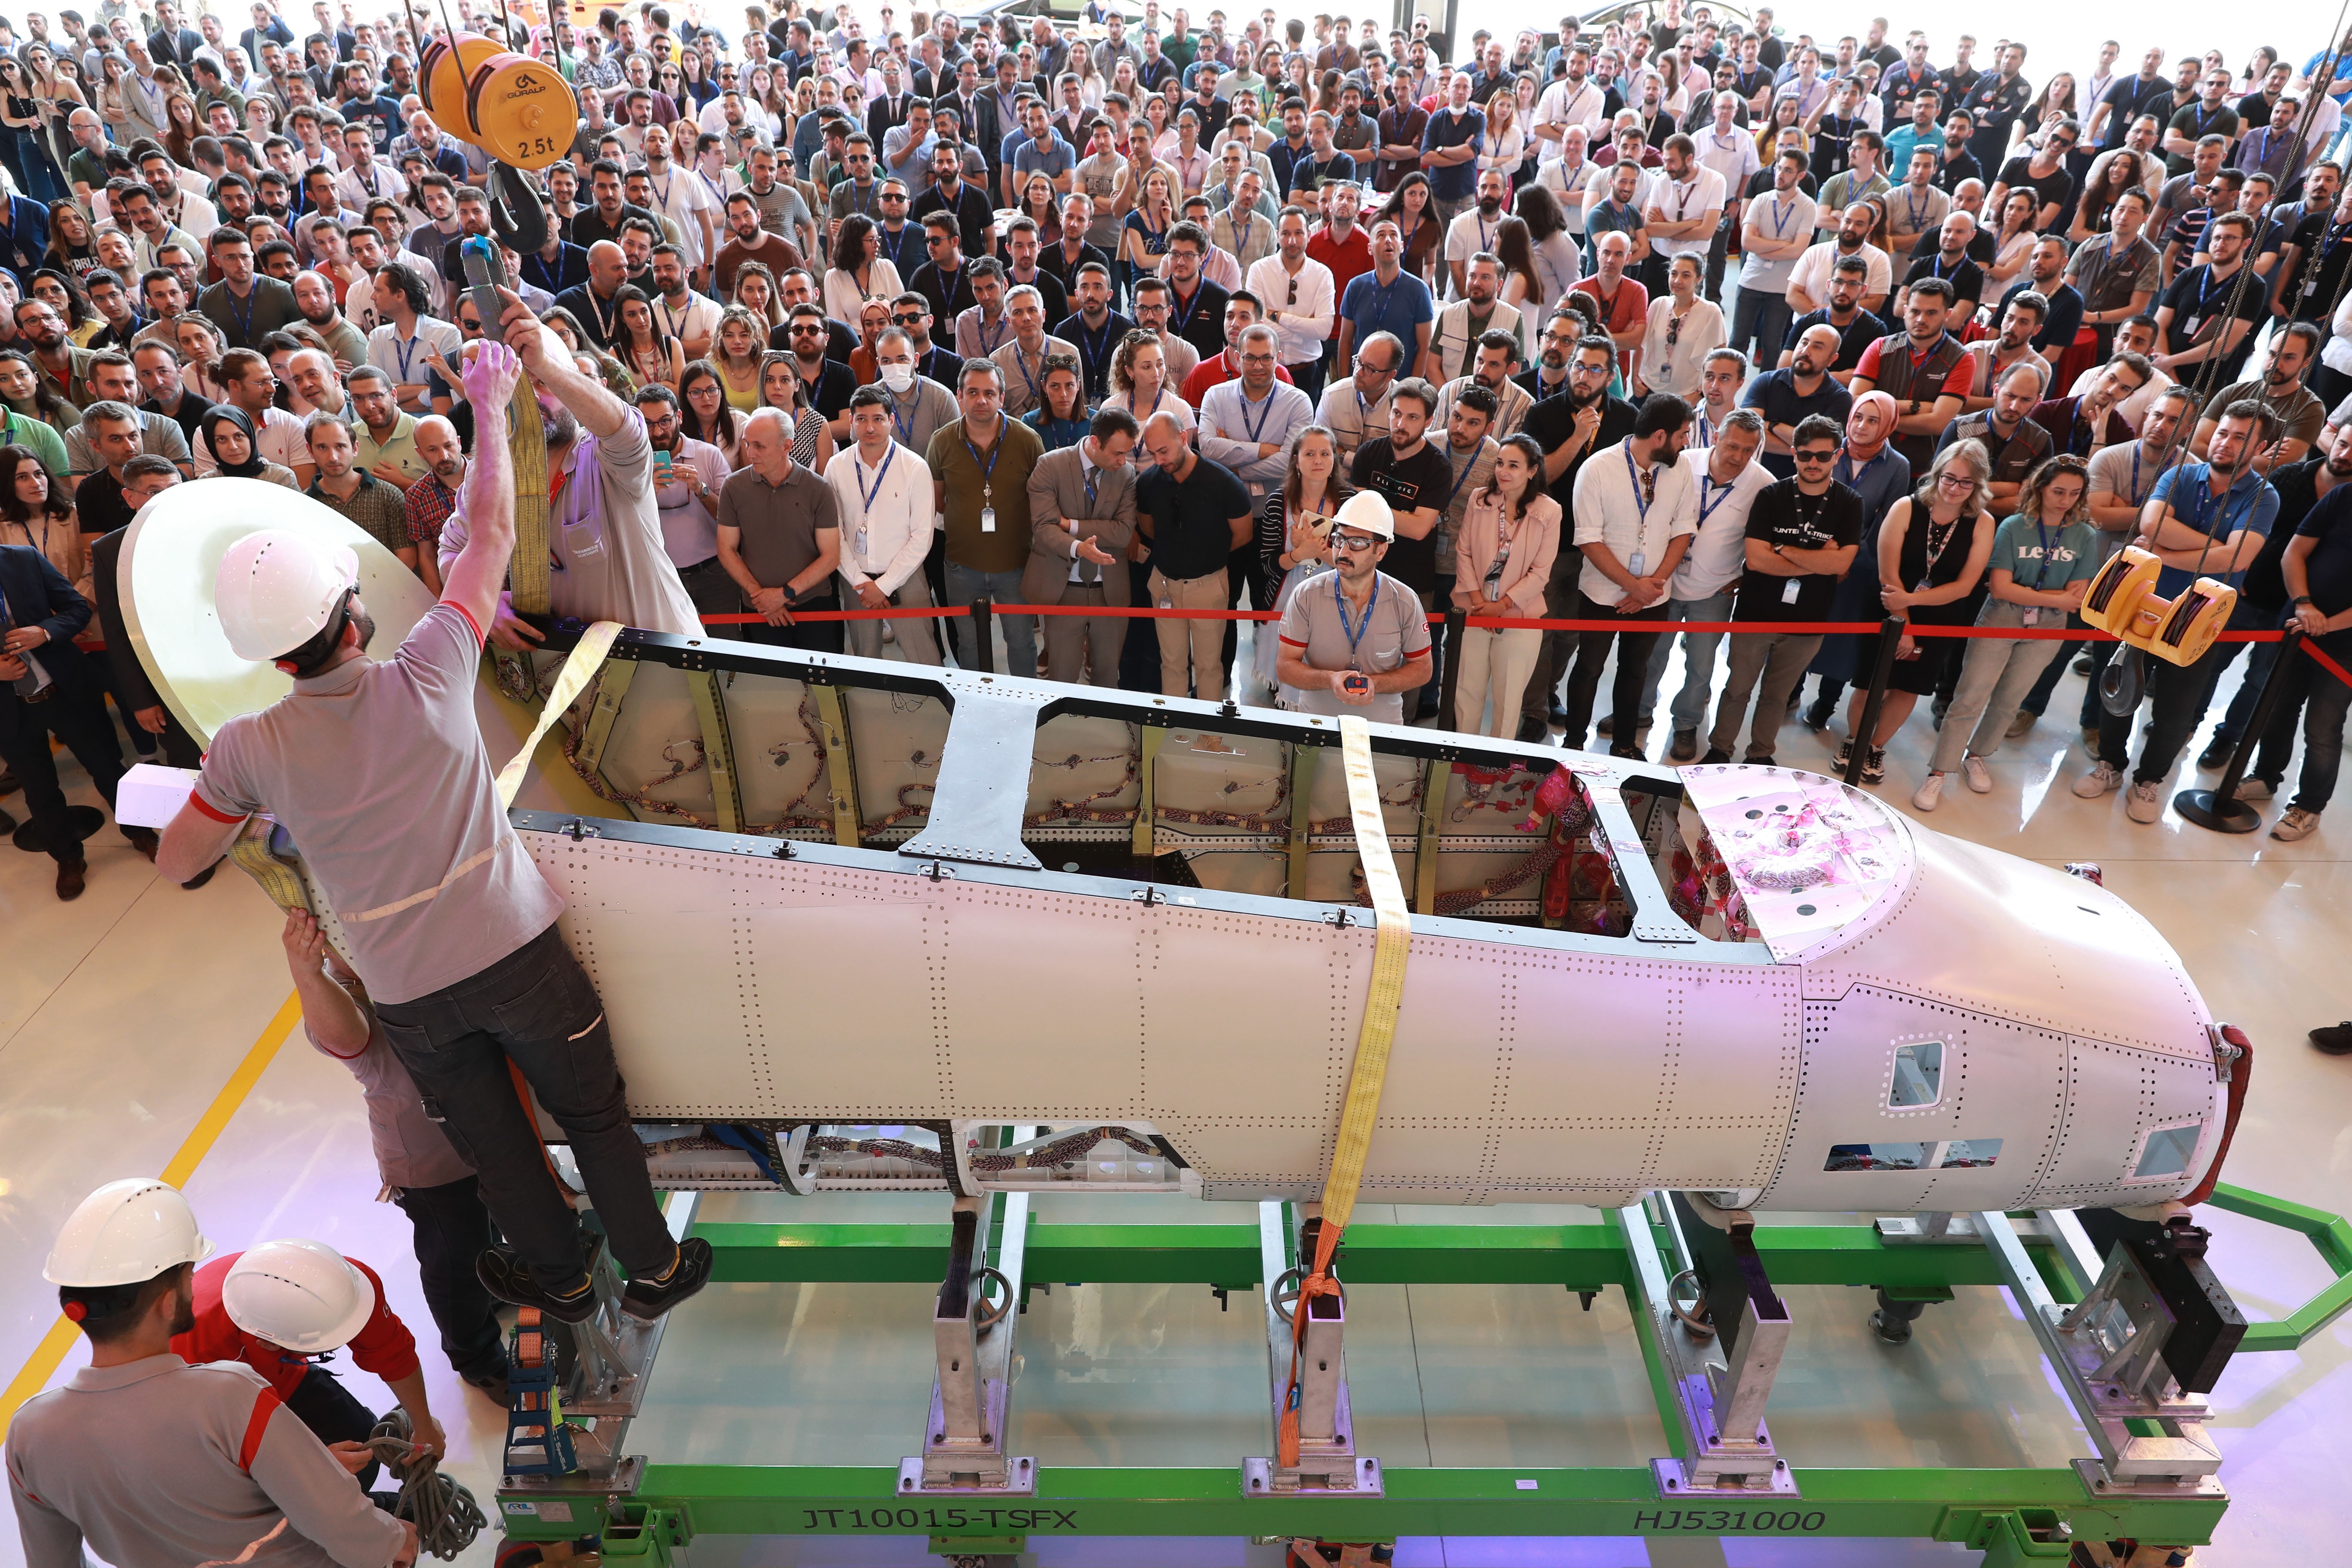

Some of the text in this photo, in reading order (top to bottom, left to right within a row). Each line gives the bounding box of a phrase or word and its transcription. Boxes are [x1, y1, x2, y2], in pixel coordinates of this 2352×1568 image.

[507, 86, 546, 99] GÜRALP
[518, 136, 554, 159] 2.5t
[2018, 546, 2073, 562] Lei's
[555, 1442, 567, 1470] SpanSet
[802, 1509, 1078, 1529] JT10015-TSFX
[1633, 1510, 1826, 1531] HJ531000
